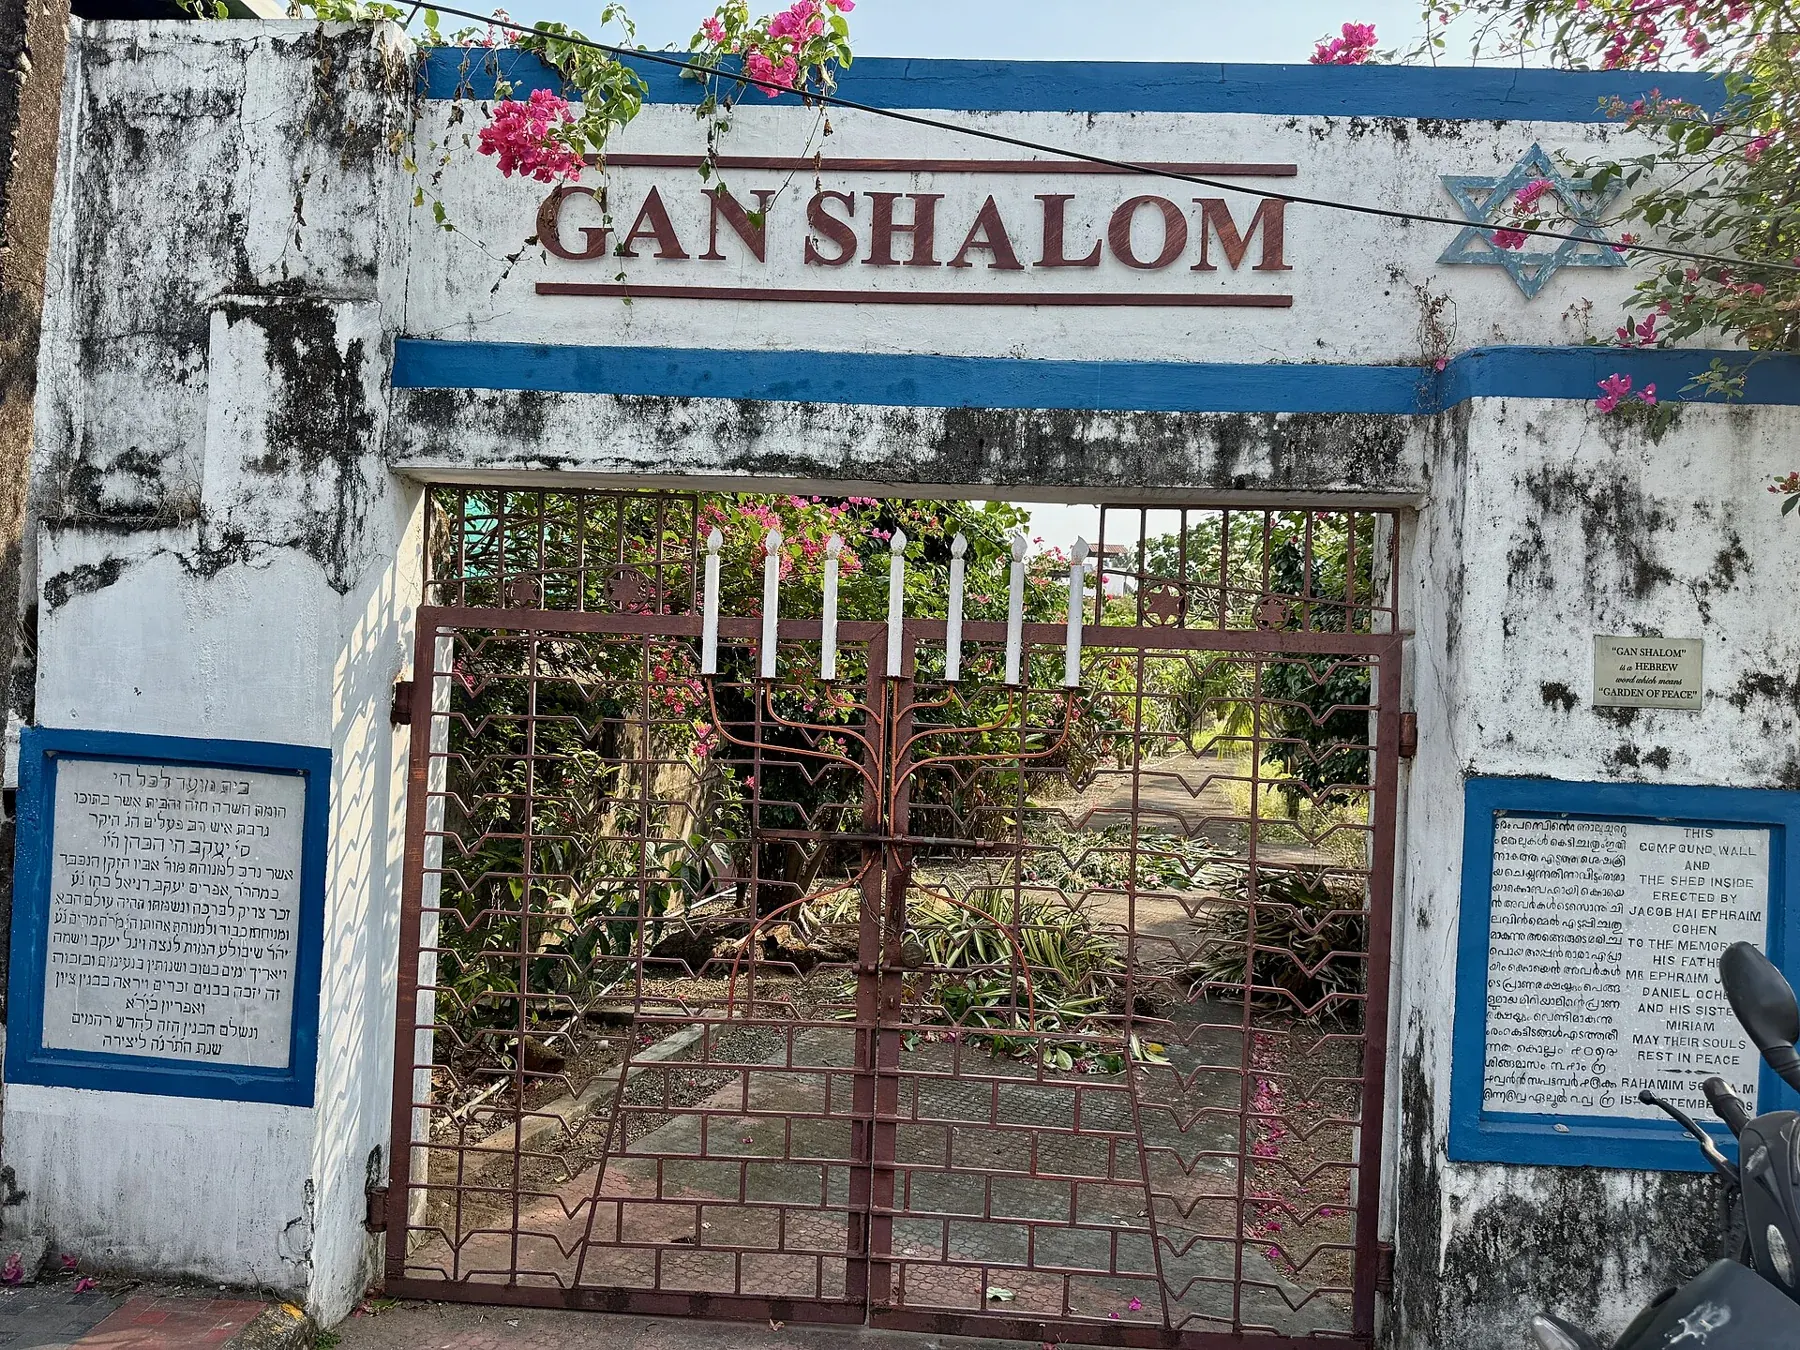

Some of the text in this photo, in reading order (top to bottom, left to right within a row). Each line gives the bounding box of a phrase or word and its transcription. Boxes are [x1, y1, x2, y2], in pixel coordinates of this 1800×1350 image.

[537, 185, 1294, 272] GAN SHALOM
[1635, 662, 1678, 672] HEBREW
[1615, 676, 1637, 684] word
[1636, 676, 1657, 685] which
[1646, 689, 1661, 698] OF
[136, 765, 171, 789] לכל
[220, 780, 250, 795] בית
[114, 795, 142, 808] אשר
[210, 822, 232, 834] איש
[1684, 828, 1714, 838] THIS
[1718, 845, 1757, 856] WALL
[1684, 860, 1710, 871] AND
[266, 868, 294, 880] אשר
[1638, 874, 1754, 888] THE SHED INSIDE
[1653, 890, 1738, 904] ERECTED BY
[1628, 906, 1762, 922] JACOB HAI EPHRAIM
[1672, 924, 1718, 936] COHEN
[1628, 938, 1733, 952] TO THE MEMOR
[1653, 955, 1676, 966] HIS
[1649, 971, 1708, 984] EPHRAIM
[1642, 987, 1690, 998] DANIEL
[1638, 1002, 1735, 1017] AND HIS SISTE
[1666, 1020, 1715, 1032] MIRIAM
[1632, 1034, 1746, 1050] MAY THEIR SOULS
[1638, 1050, 1740, 1066] REST IN PEACE
[1622, 1078, 1684, 1090] RAHAMIM
